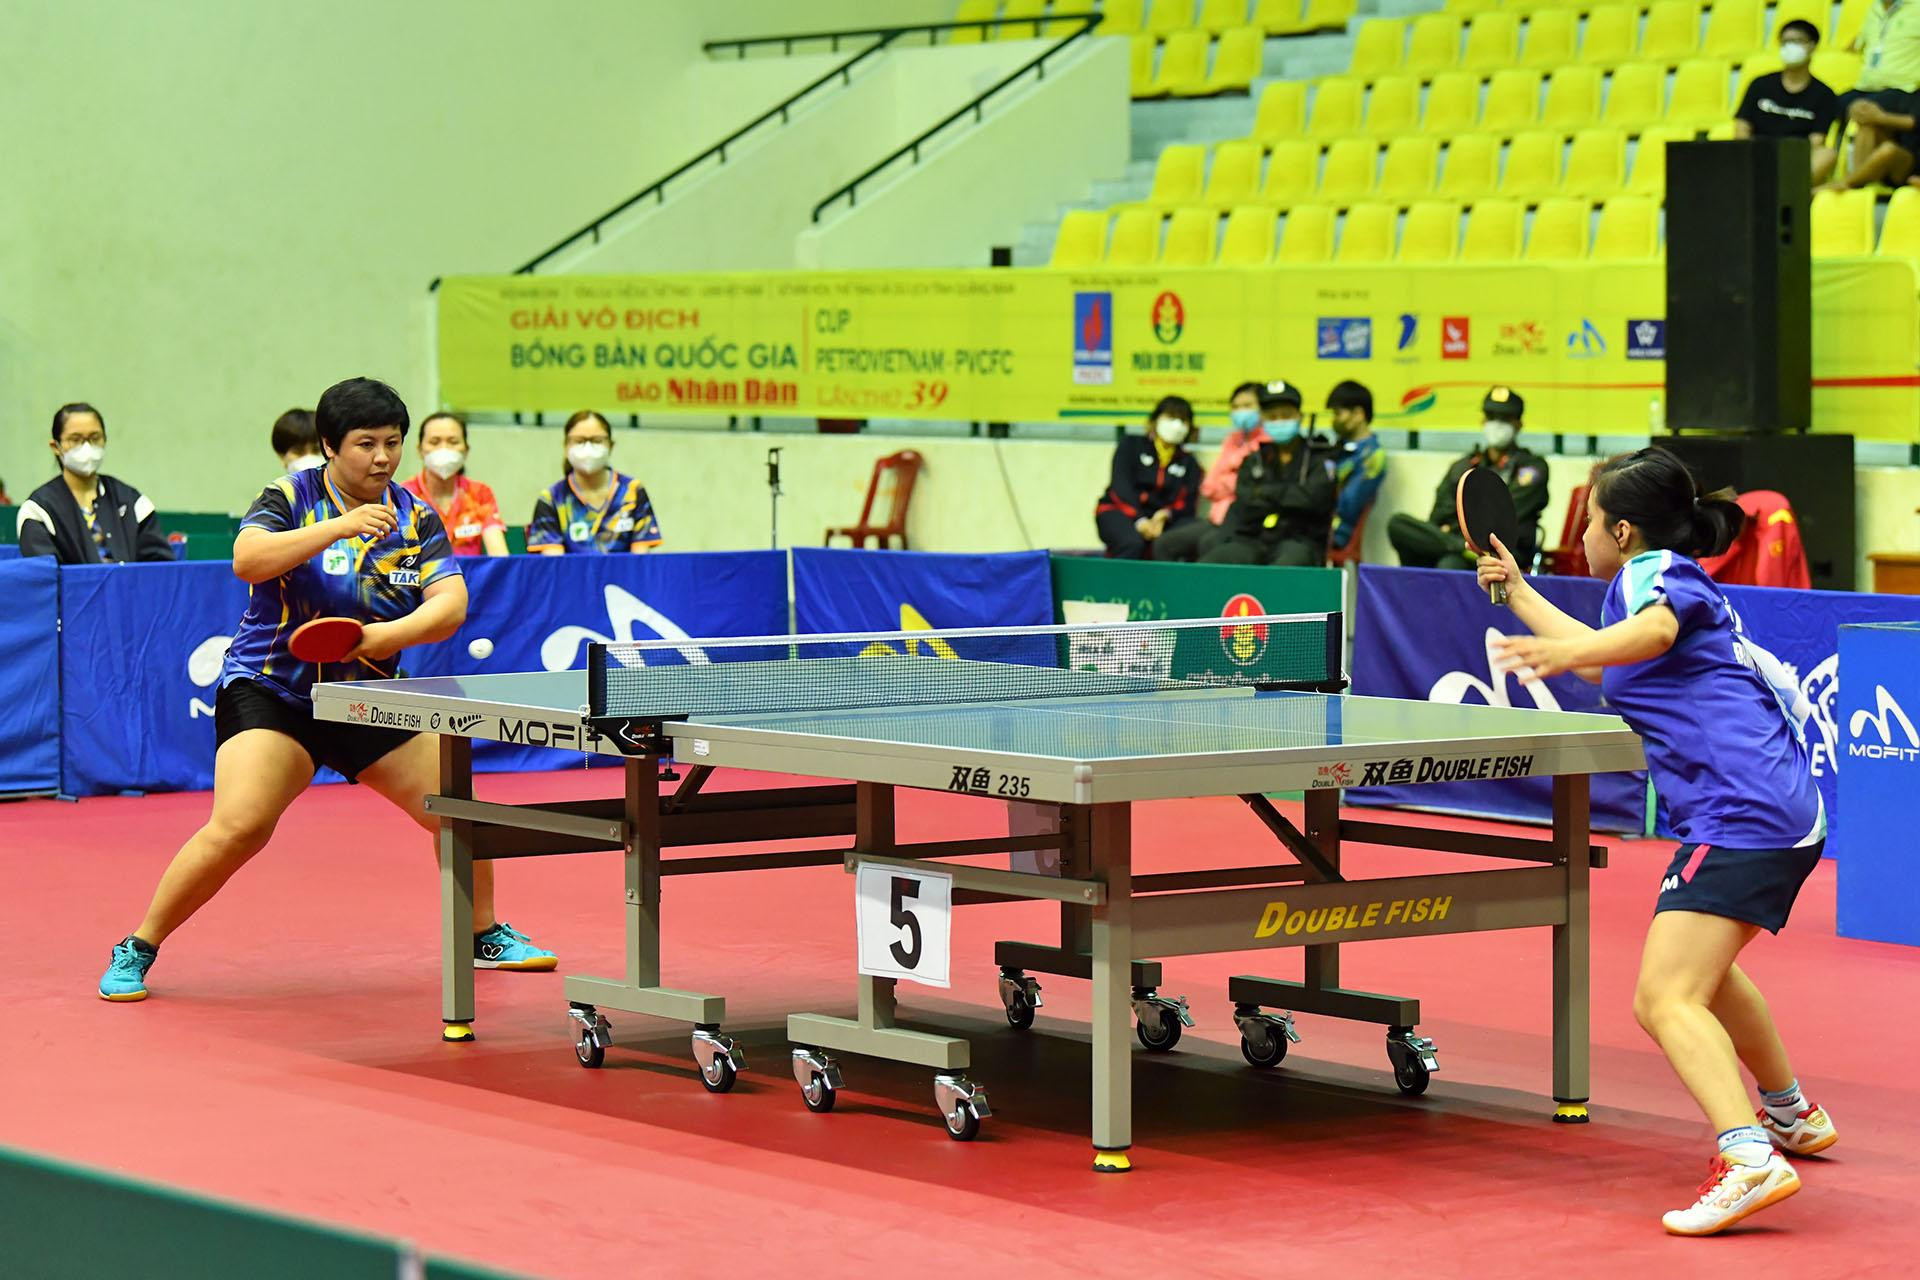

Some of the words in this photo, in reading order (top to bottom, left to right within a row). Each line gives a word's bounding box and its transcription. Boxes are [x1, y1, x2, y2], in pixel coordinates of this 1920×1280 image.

[624, 308, 700, 336] ĐỊCH
[655, 333, 737, 368] QUỐC
[748, 343, 799, 368] GIA
[667, 378, 737, 406] Nhân
[744, 378, 798, 406] Dân
[904, 378, 949, 411] 39
[392, 572, 420, 584] TAK
[371, 706, 402, 726] DOUBLE
[404, 714, 421, 728] FISH
[500, 717, 602, 753] MOFIT
[1849, 743, 1919, 762] MOFIT
[948, 766, 990, 794] 双鱼
[998, 774, 1031, 797] 235
[1359, 758, 1413, 786] 双鱼
[1416, 757, 1491, 782] DOUBLE
[1492, 755, 1534, 777] FISH
[889, 876, 922, 970] 5
[1254, 902, 1383, 938] DOUBLE
[1384, 896, 1453, 925] FISH
